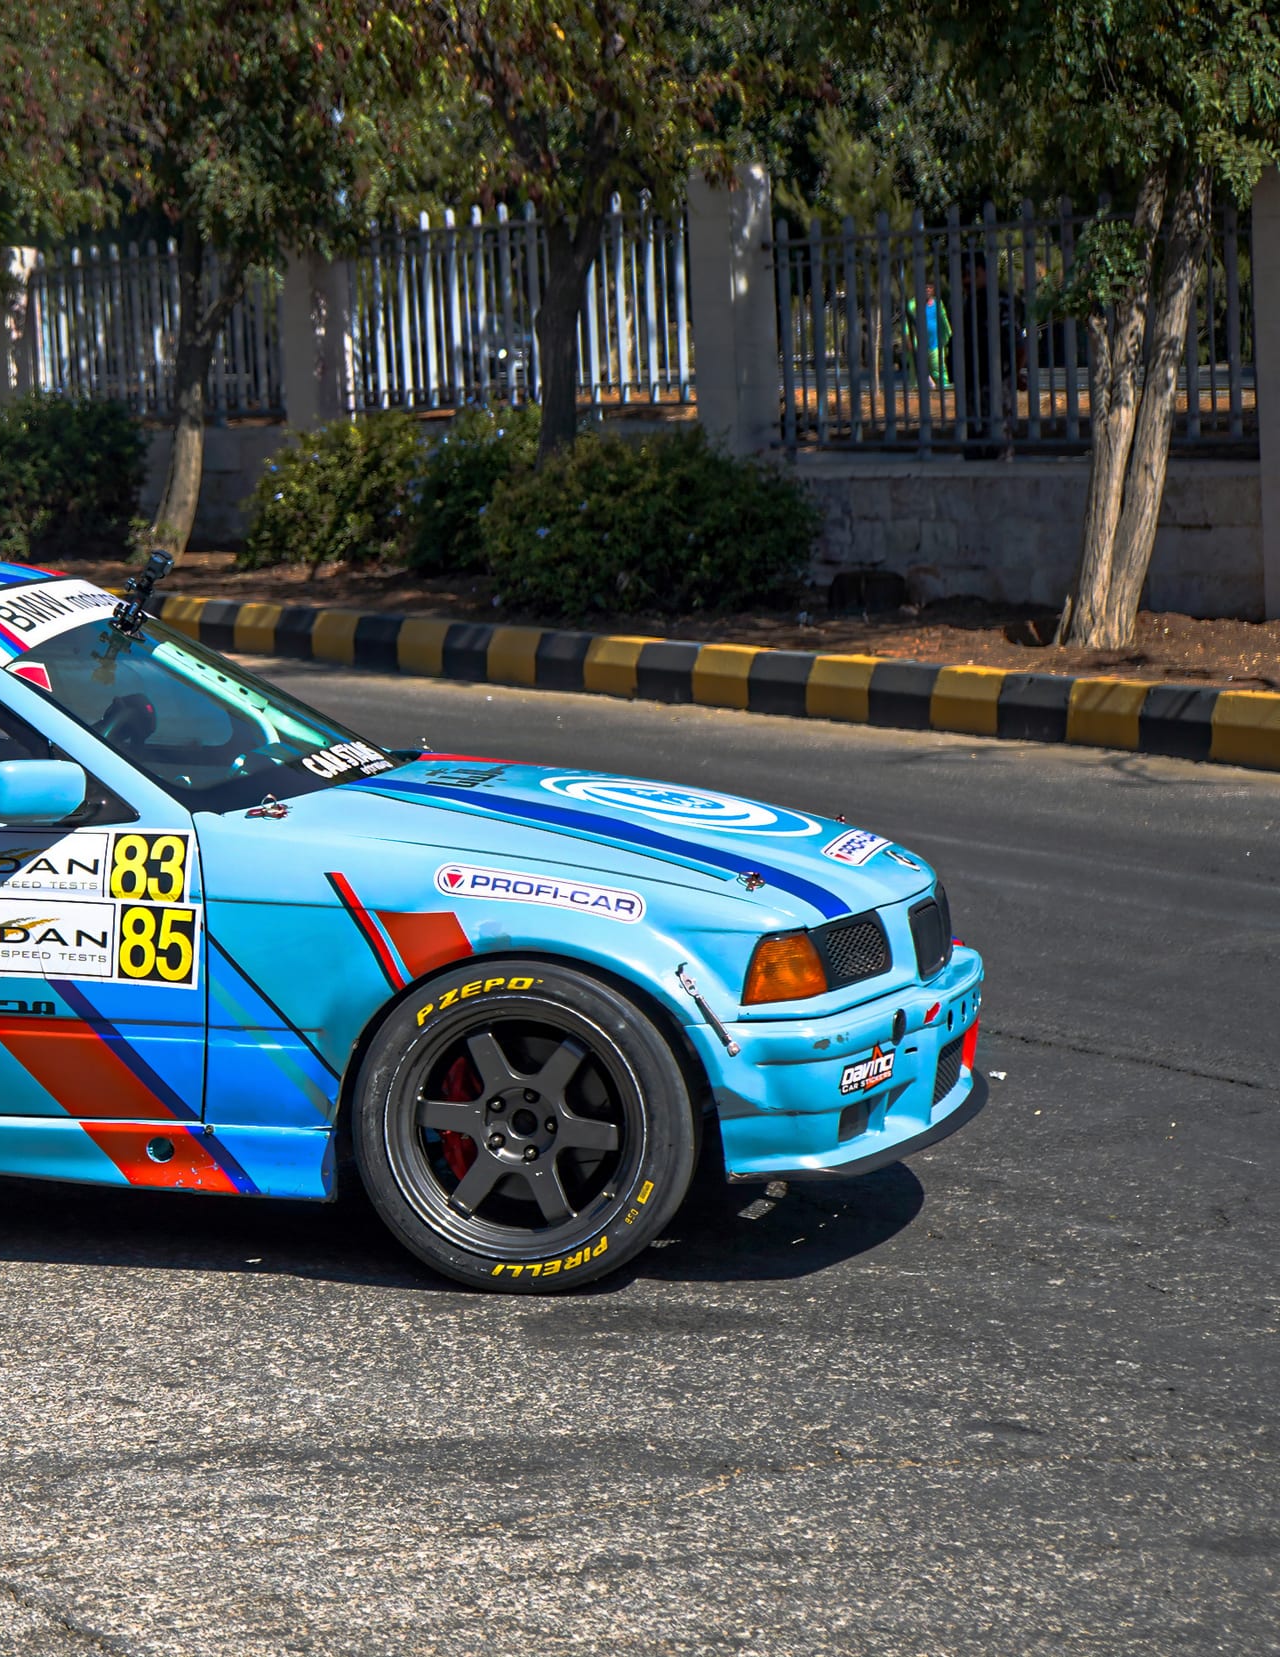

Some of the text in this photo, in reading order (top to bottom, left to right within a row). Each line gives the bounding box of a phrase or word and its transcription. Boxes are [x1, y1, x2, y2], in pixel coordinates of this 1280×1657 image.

[49, 881, 98, 890] TESTS
[110, 834, 186, 901] 83
[470, 875, 637, 917] PROFI-CAR
[1, 950, 107, 963] SPEED TESTS
[119, 907, 193, 981] 85
[416, 1003, 434, 1027] P
[491, 1235, 610, 1279] PIRELLI
